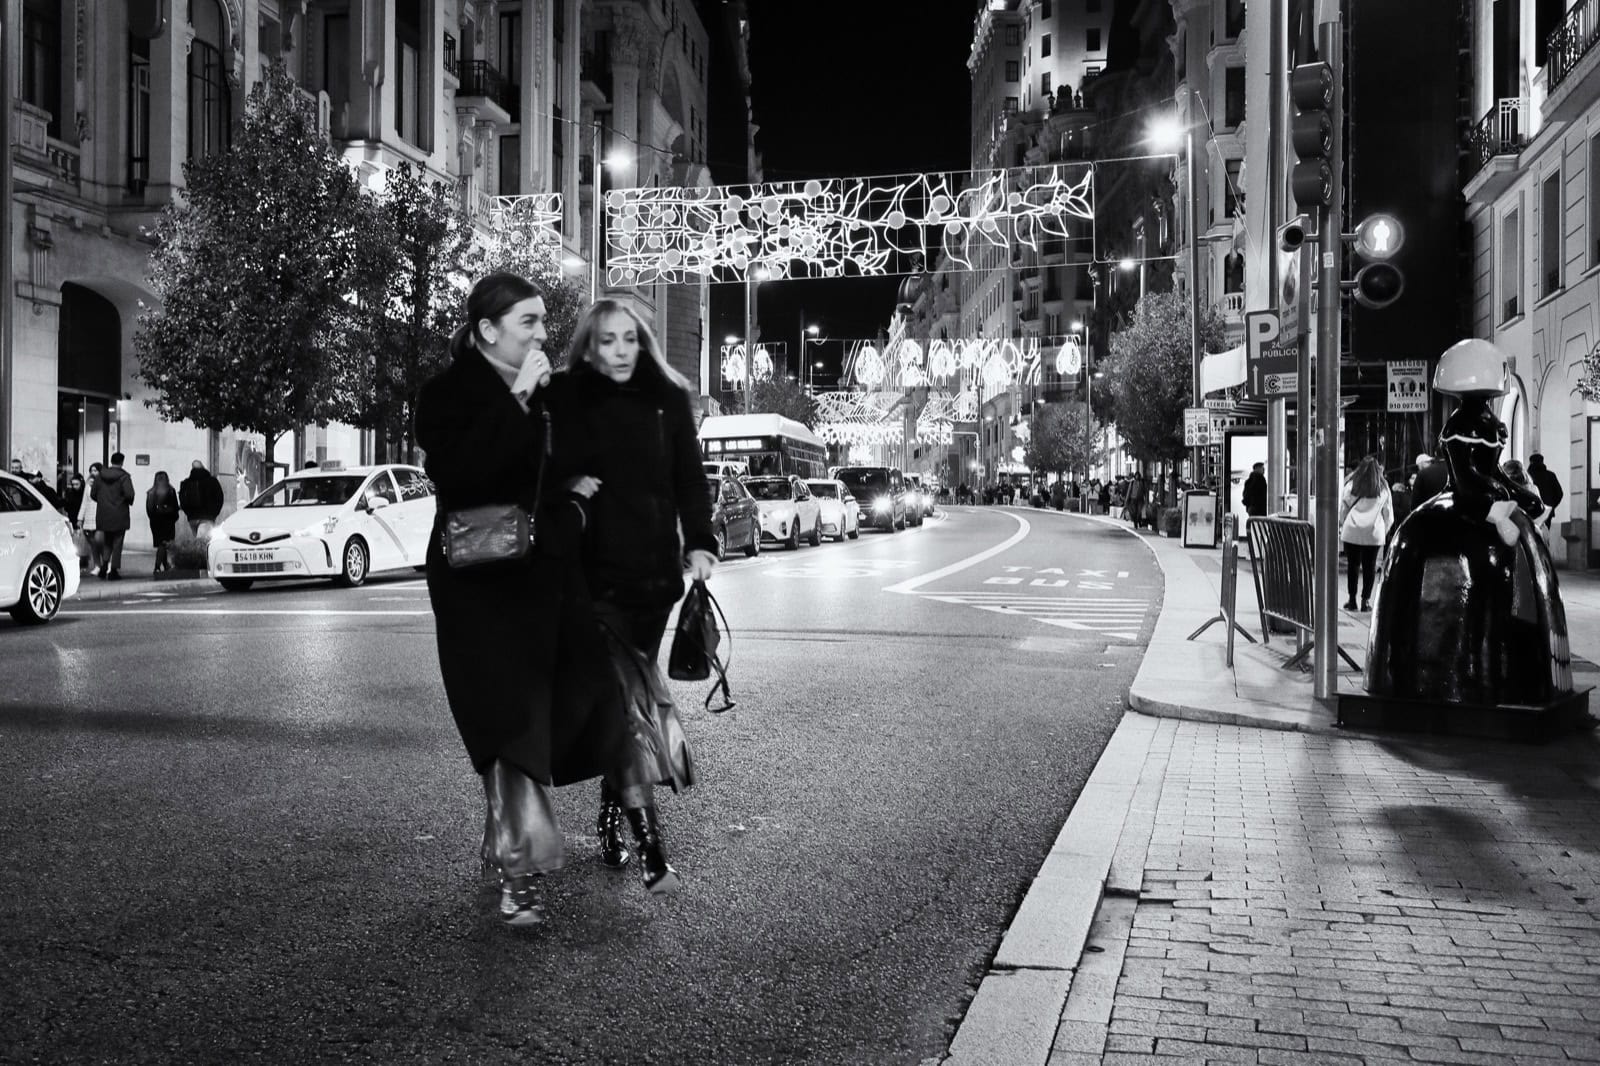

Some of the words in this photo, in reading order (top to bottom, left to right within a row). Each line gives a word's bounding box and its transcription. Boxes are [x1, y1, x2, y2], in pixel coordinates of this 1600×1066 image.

[1249, 313, 1279, 359] P
[1262, 347, 1298, 358] PÚBLICO
[1001, 565, 1130, 578] TAXI
[983, 577, 1115, 590] BUS
